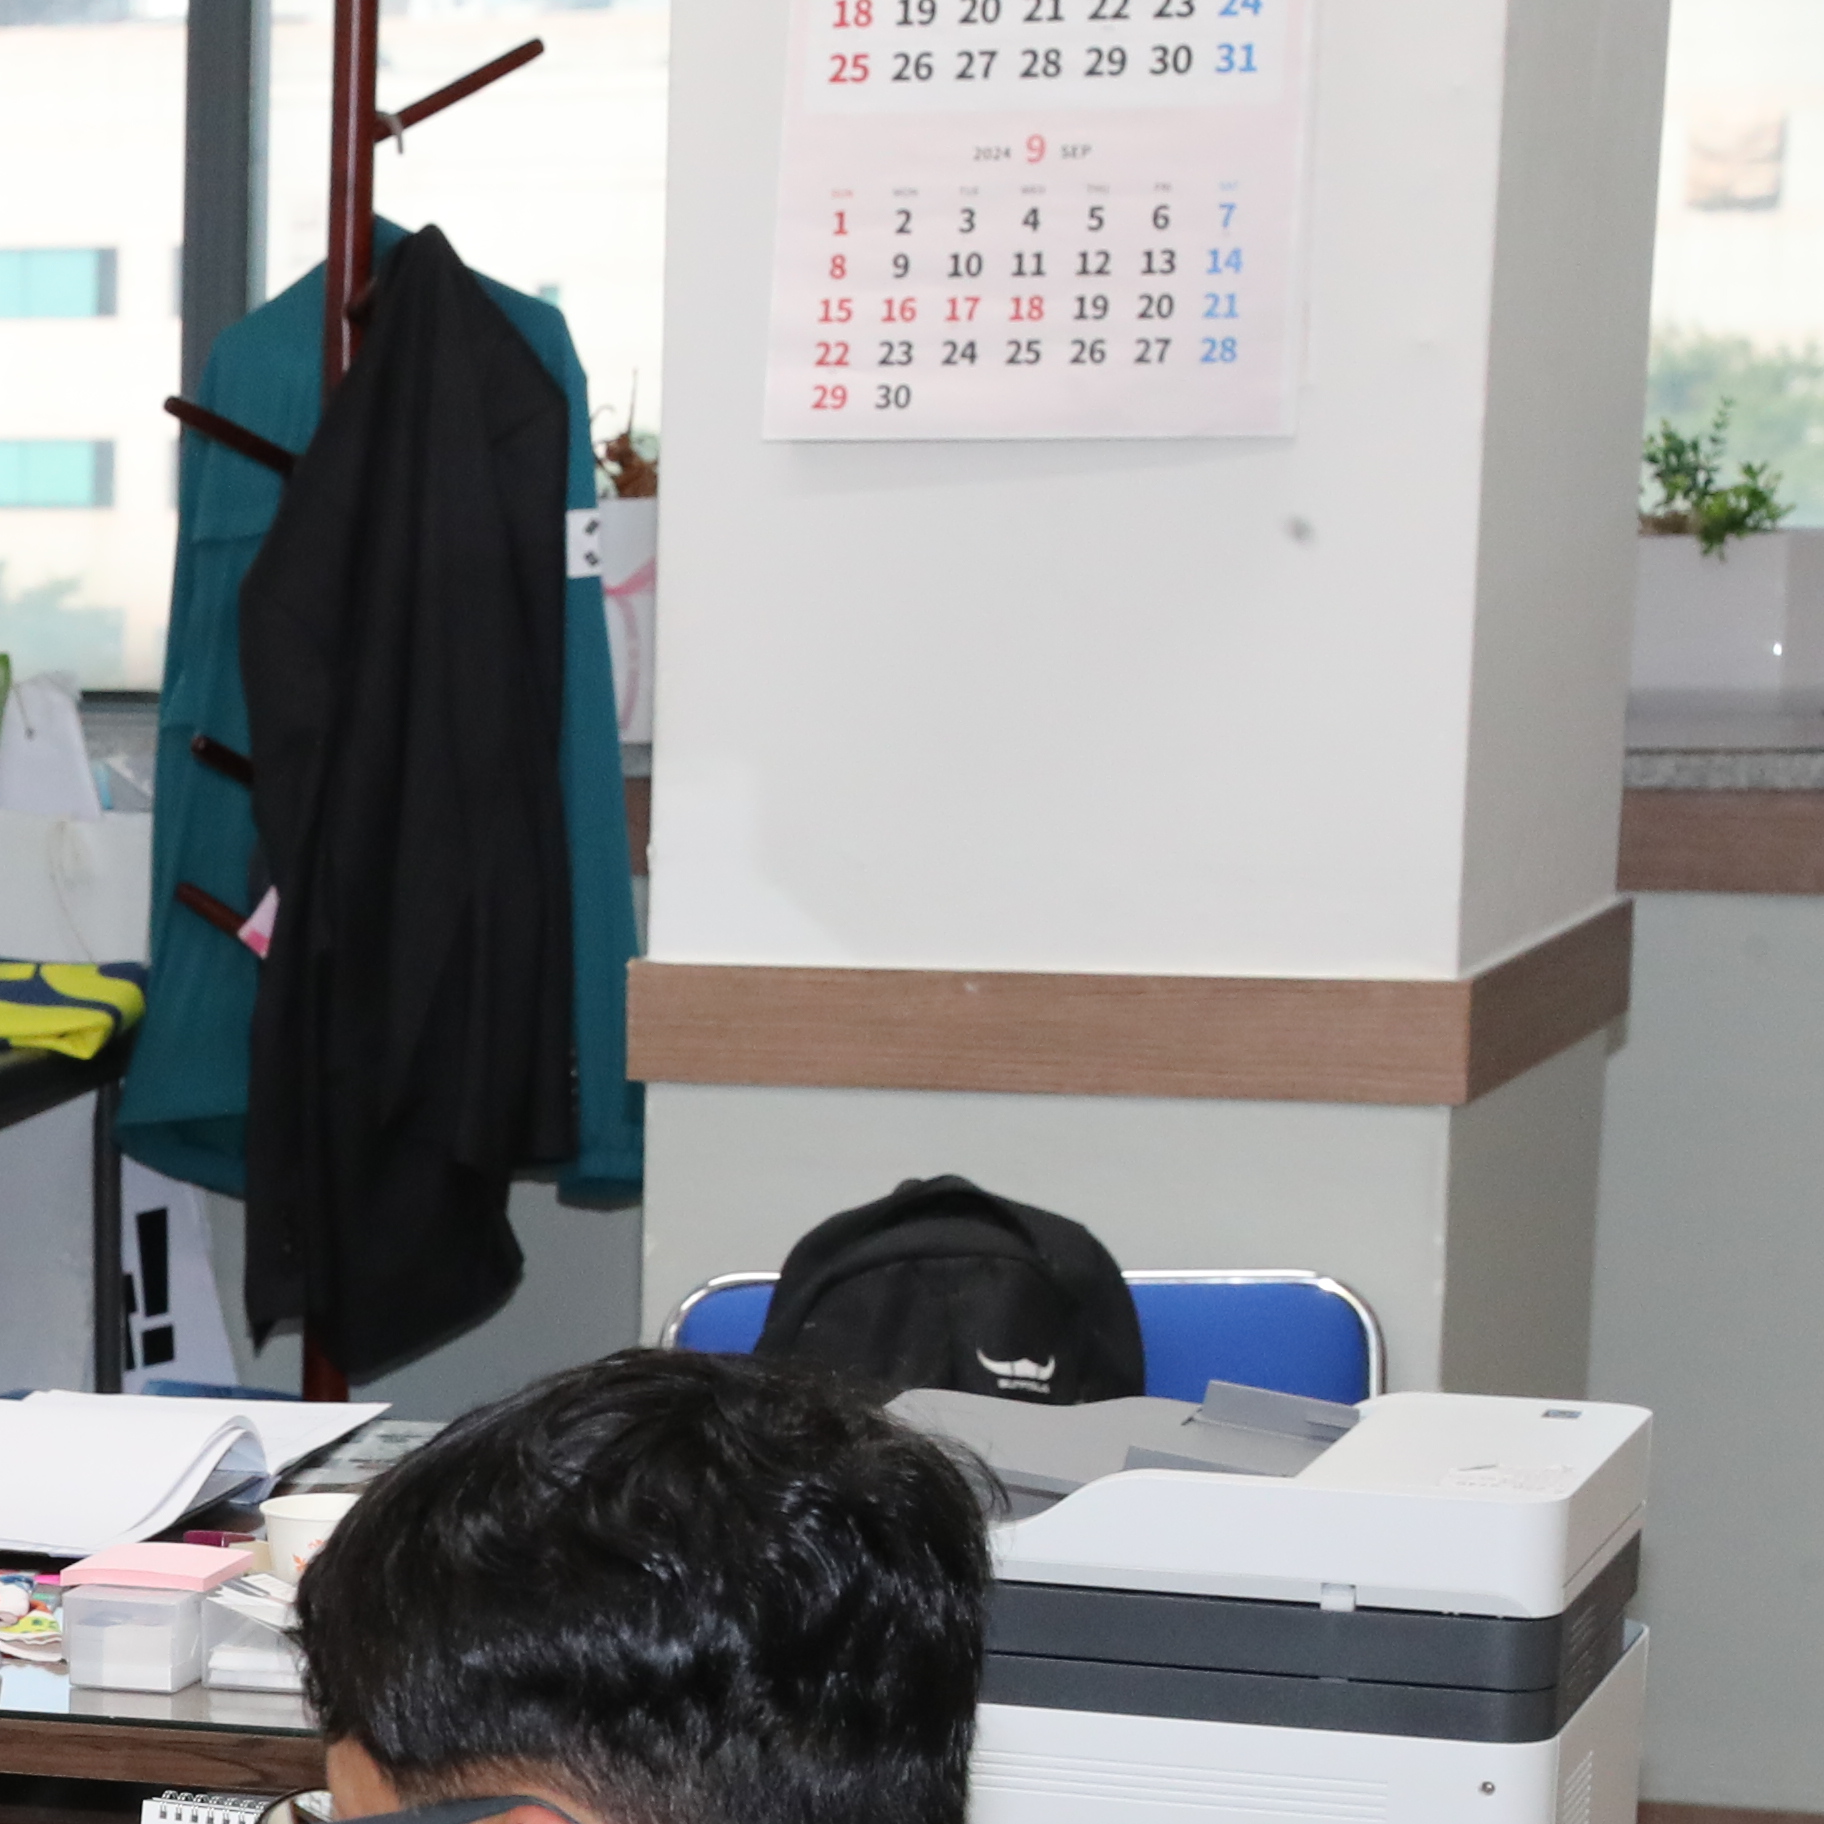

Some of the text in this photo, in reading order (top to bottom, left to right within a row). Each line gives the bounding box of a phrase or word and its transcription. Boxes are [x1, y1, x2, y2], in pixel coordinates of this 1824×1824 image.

[834, 0, 872, 28] 18
[897, 0, 936, 25] 19
[959, 0, 1001, 24] 20
[1024, 0, 1063, 22] 21
[1089, 0, 1129, 20] 22
[829, 43, 1257, 83] 25 26 27 28 29 30 31
[974, 134, 1091, 164] 2024 9 SEP
[834, 203, 1236, 235] 1 2 3 4 5 6 7
[830, 248, 1242, 279] 8 9 10 11 12 13 14
[819, 293, 1239, 323] 15 16 17 18 19 20 21
[815, 337, 1237, 366] 22 23 24 25 26 27 28
[812, 385, 911, 410] 29 30
